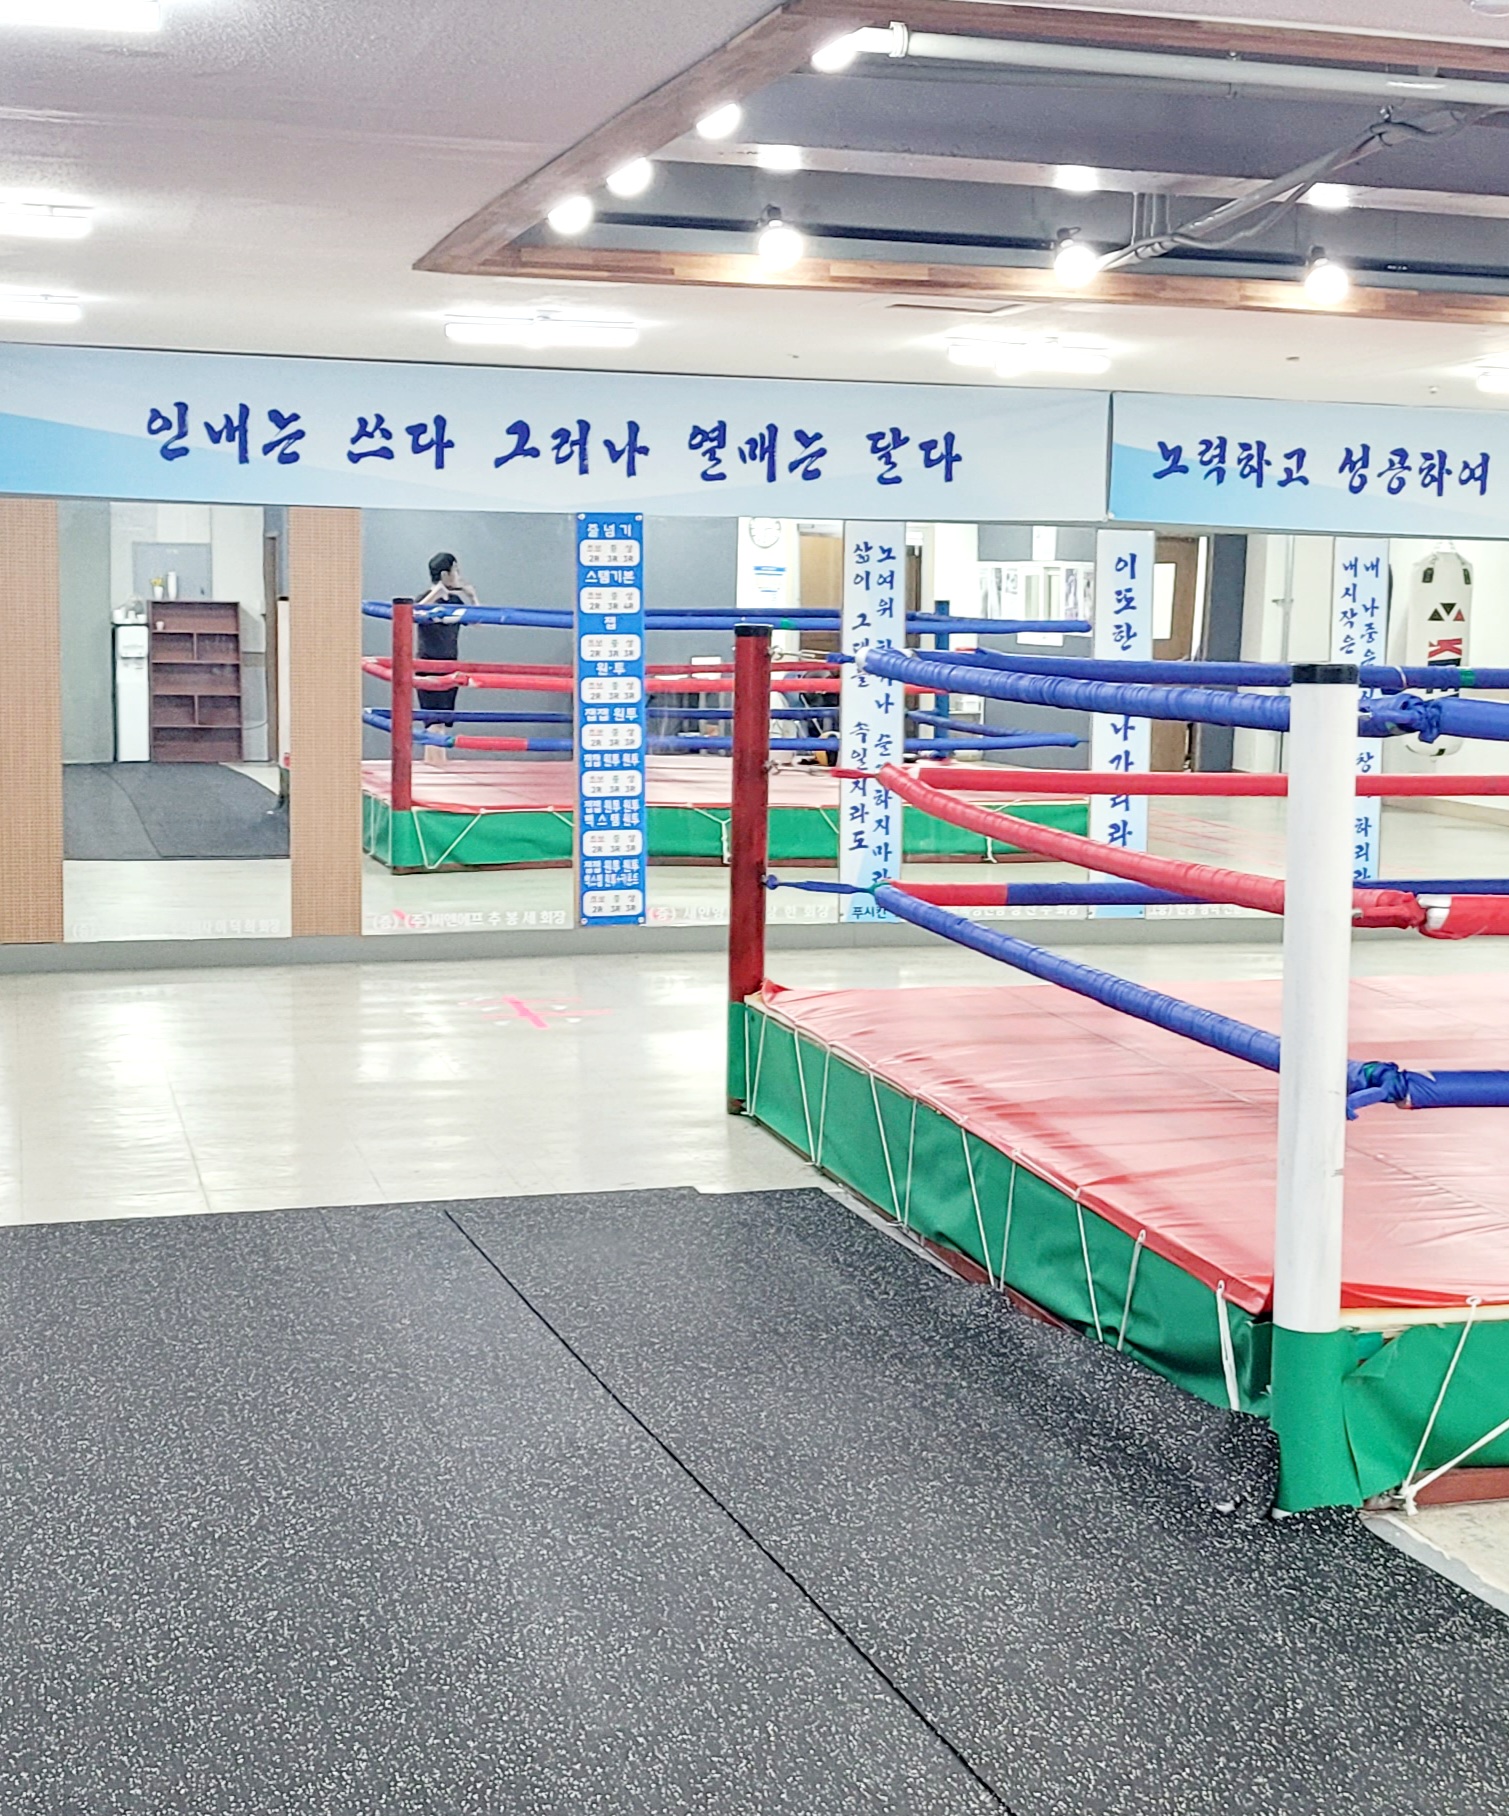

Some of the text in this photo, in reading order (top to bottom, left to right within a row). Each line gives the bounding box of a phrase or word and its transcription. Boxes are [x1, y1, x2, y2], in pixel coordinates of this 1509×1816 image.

[148, 402, 962, 486] 인내는 쓰다 그러나 열매는 달다
[1153, 437, 1309, 488] 노력하고
[1339, 444, 1490, 496] 성공하여
[853, 541, 873, 591] 삶이
[876, 545, 897, 618] 노여워
[1113, 552, 1138, 651] 이또한
